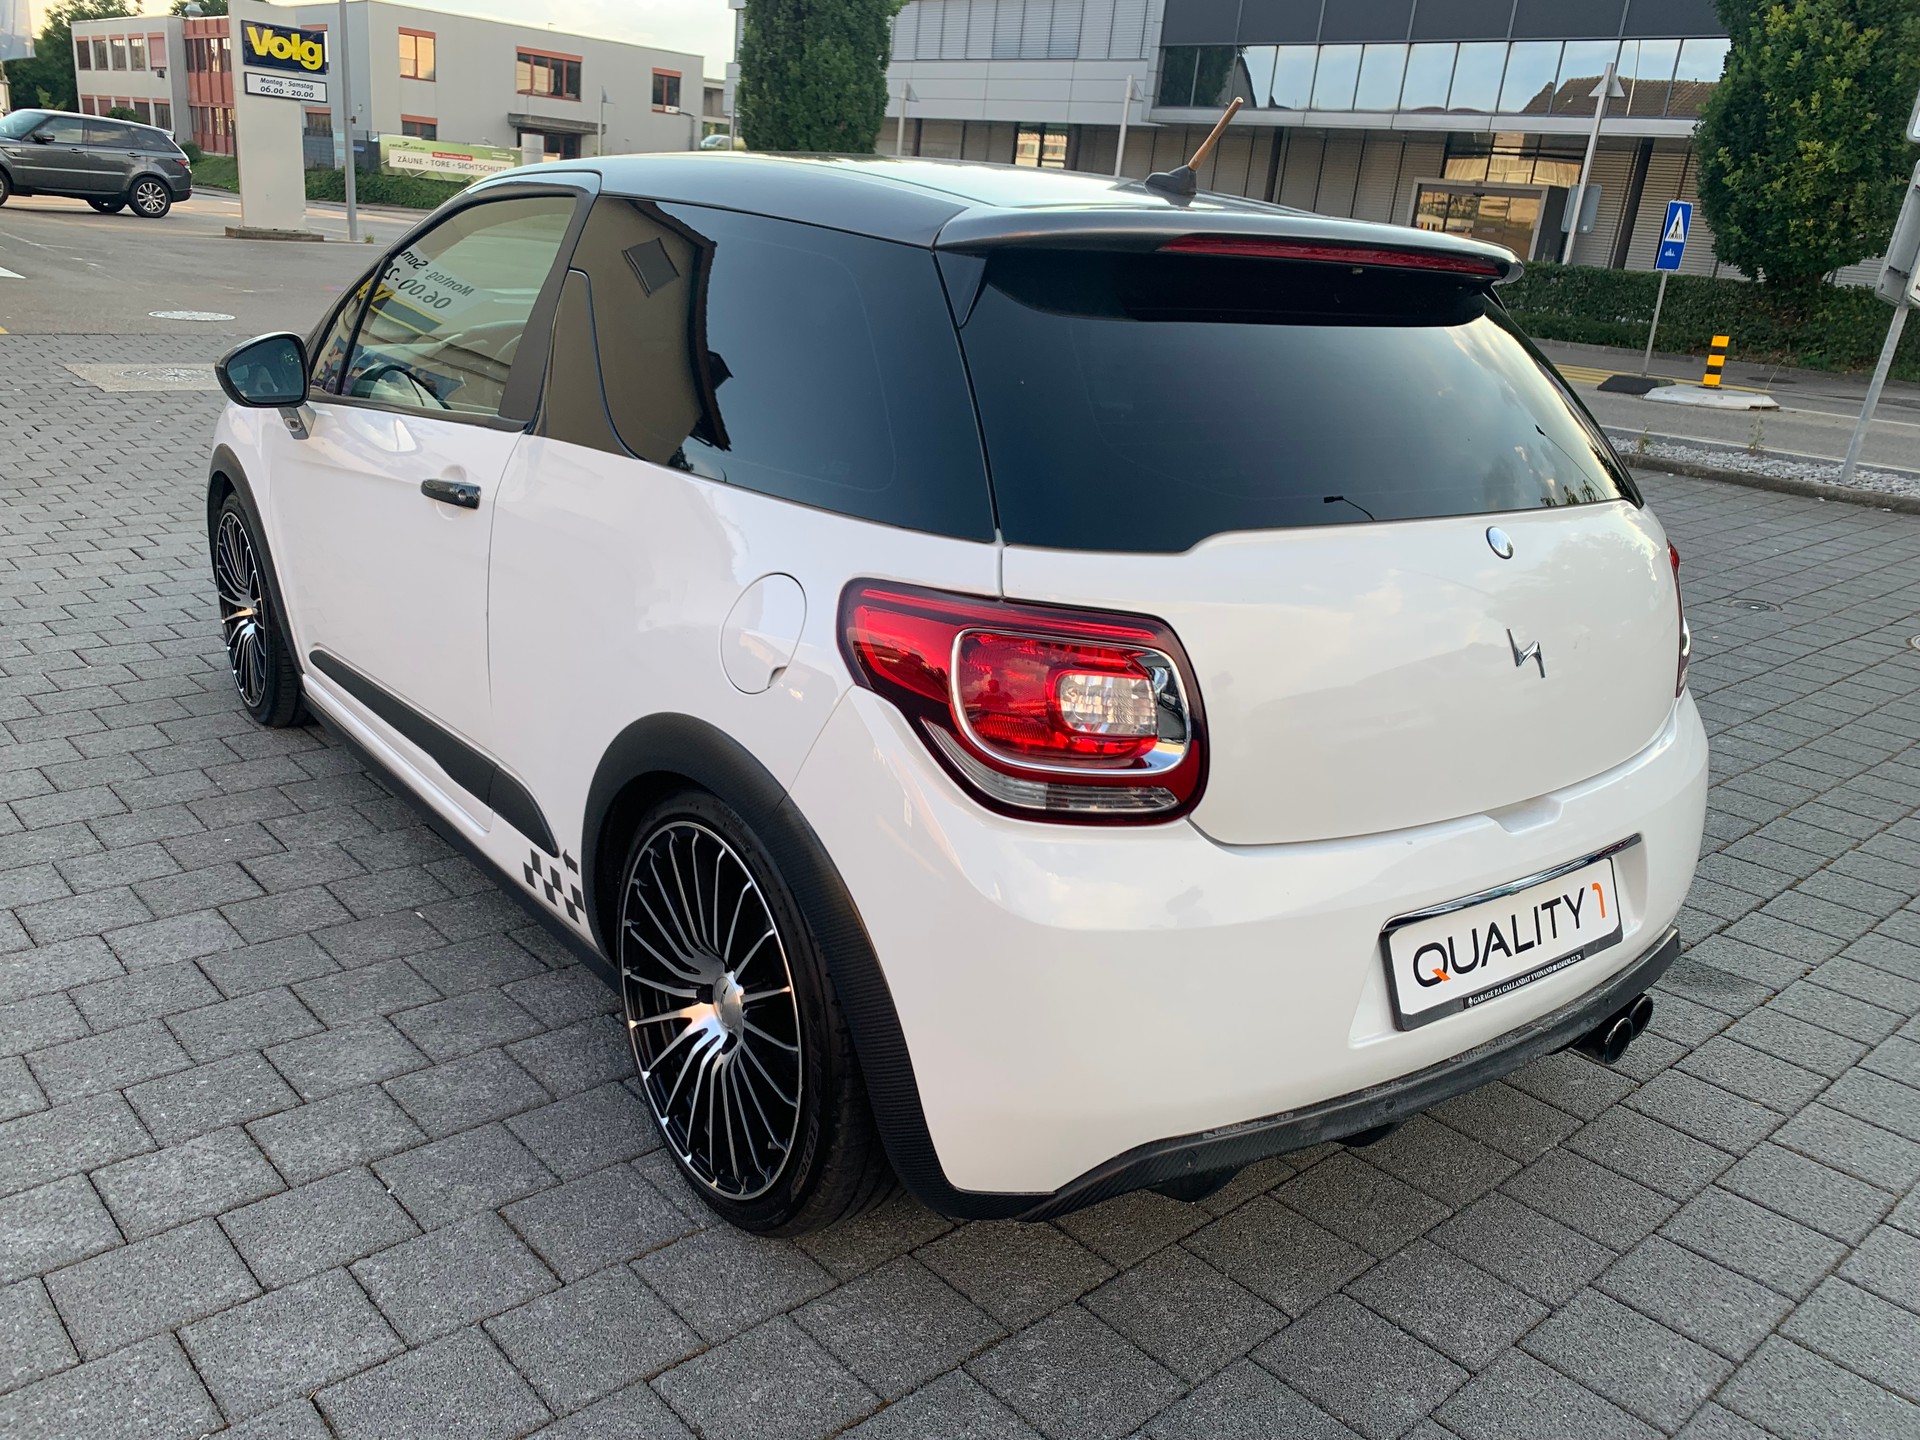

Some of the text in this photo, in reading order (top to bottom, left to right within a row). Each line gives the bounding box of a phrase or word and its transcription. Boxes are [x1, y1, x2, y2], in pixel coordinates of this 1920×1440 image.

[246, 26, 323, 71] Volg
[260, 77, 283, 87] Montag
[288, 81, 314, 91] Samstag
[260, 85, 284, 95] 06.00
[291, 89, 315, 98] 20.00
[397, 155, 424, 165] ZÄUNE
[430, 159, 450, 168] TORE
[1473, 989, 1495, 1005] GARAGE
